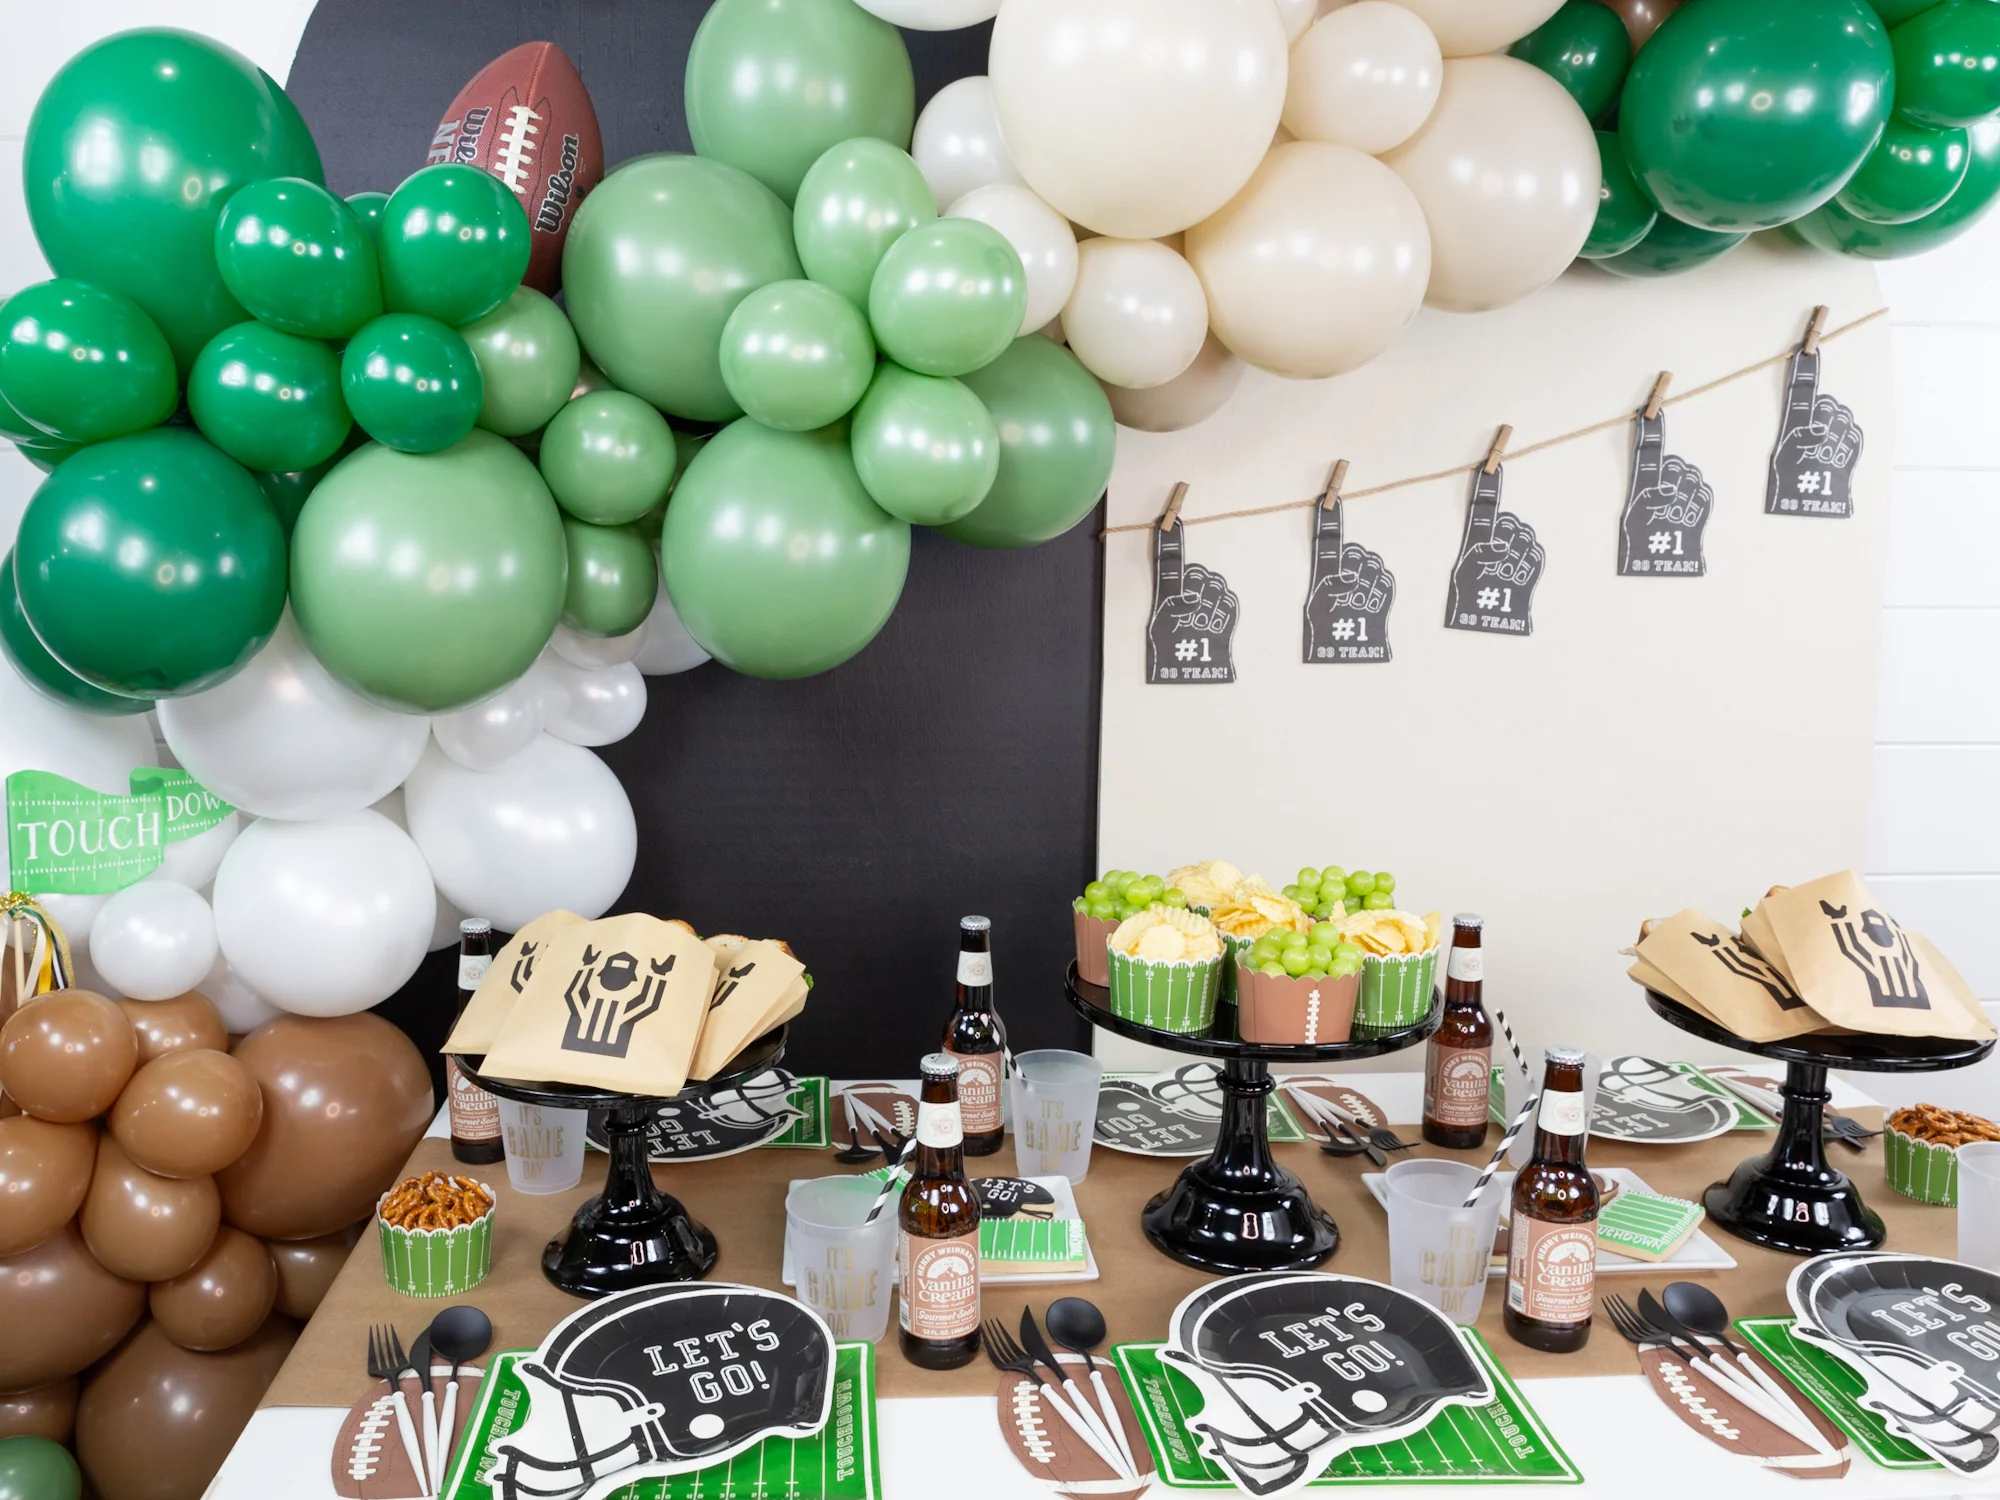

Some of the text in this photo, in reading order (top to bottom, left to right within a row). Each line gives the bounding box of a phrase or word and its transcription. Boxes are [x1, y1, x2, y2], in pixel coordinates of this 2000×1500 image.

[427, 119, 460, 164] NF
[534, 134, 579, 234] Wilson
[1797, 471, 1832, 496] #1
[1780, 498, 1846, 514] GO TEAM!
[1647, 530, 1684, 555] #1
[1632, 559, 1699, 573] GO TEAM!
[1476, 586, 1512, 612] #1
[1332, 617, 1368, 641] #1
[1459, 613, 1525, 631] GO TEAM!
[1175, 637, 1212, 662] #1
[1317, 646, 1384, 658] GO TEAM!
[1160, 667, 1228, 679] GO TEAM!
[166, 791, 232, 822] DOW
[17, 812, 159, 860] TOUCH
[958, 1085, 996, 1096] anilla
[1443, 1077, 1487, 1089] Vanilla
[646, 1118, 683, 1138] GO
[1024, 1115, 1082, 1155] GAME
[1597, 1112, 1670, 1136] LET
[506, 1125, 564, 1159] GAME
[647, 1130, 720, 1157] LET
[981, 1178, 1036, 1194] LET'S
[987, 1188, 1018, 1202] GO!
[1537, 1235, 1559, 1260] HENRY
[1598, 1226, 1664, 1250] UCHDOWN
[826, 1246, 855, 1271] IT'S
[917, 1250, 936, 1276] HENRY
[1537, 1260, 1593, 1276] Vanilla
[805, 1266, 879, 1311] GAME
[917, 1274, 975, 1291] Vanilla
[1535, 1293, 1576, 1304] Gourmet
[1871, 1282, 1991, 1336] LET'S
[827, 1313, 853, 1336] DAY
[918, 1310, 957, 1321] Gourmet
[1258, 1302, 1386, 1359] LET'S
[643, 1318, 781, 1376] LET'S
[1321, 1340, 1405, 1381] GO!
[689, 1360, 770, 1404] GO!
[836, 1379, 854, 1481] TOUCHDOWN
[1484, 1396, 1535, 1459] TOUCH
